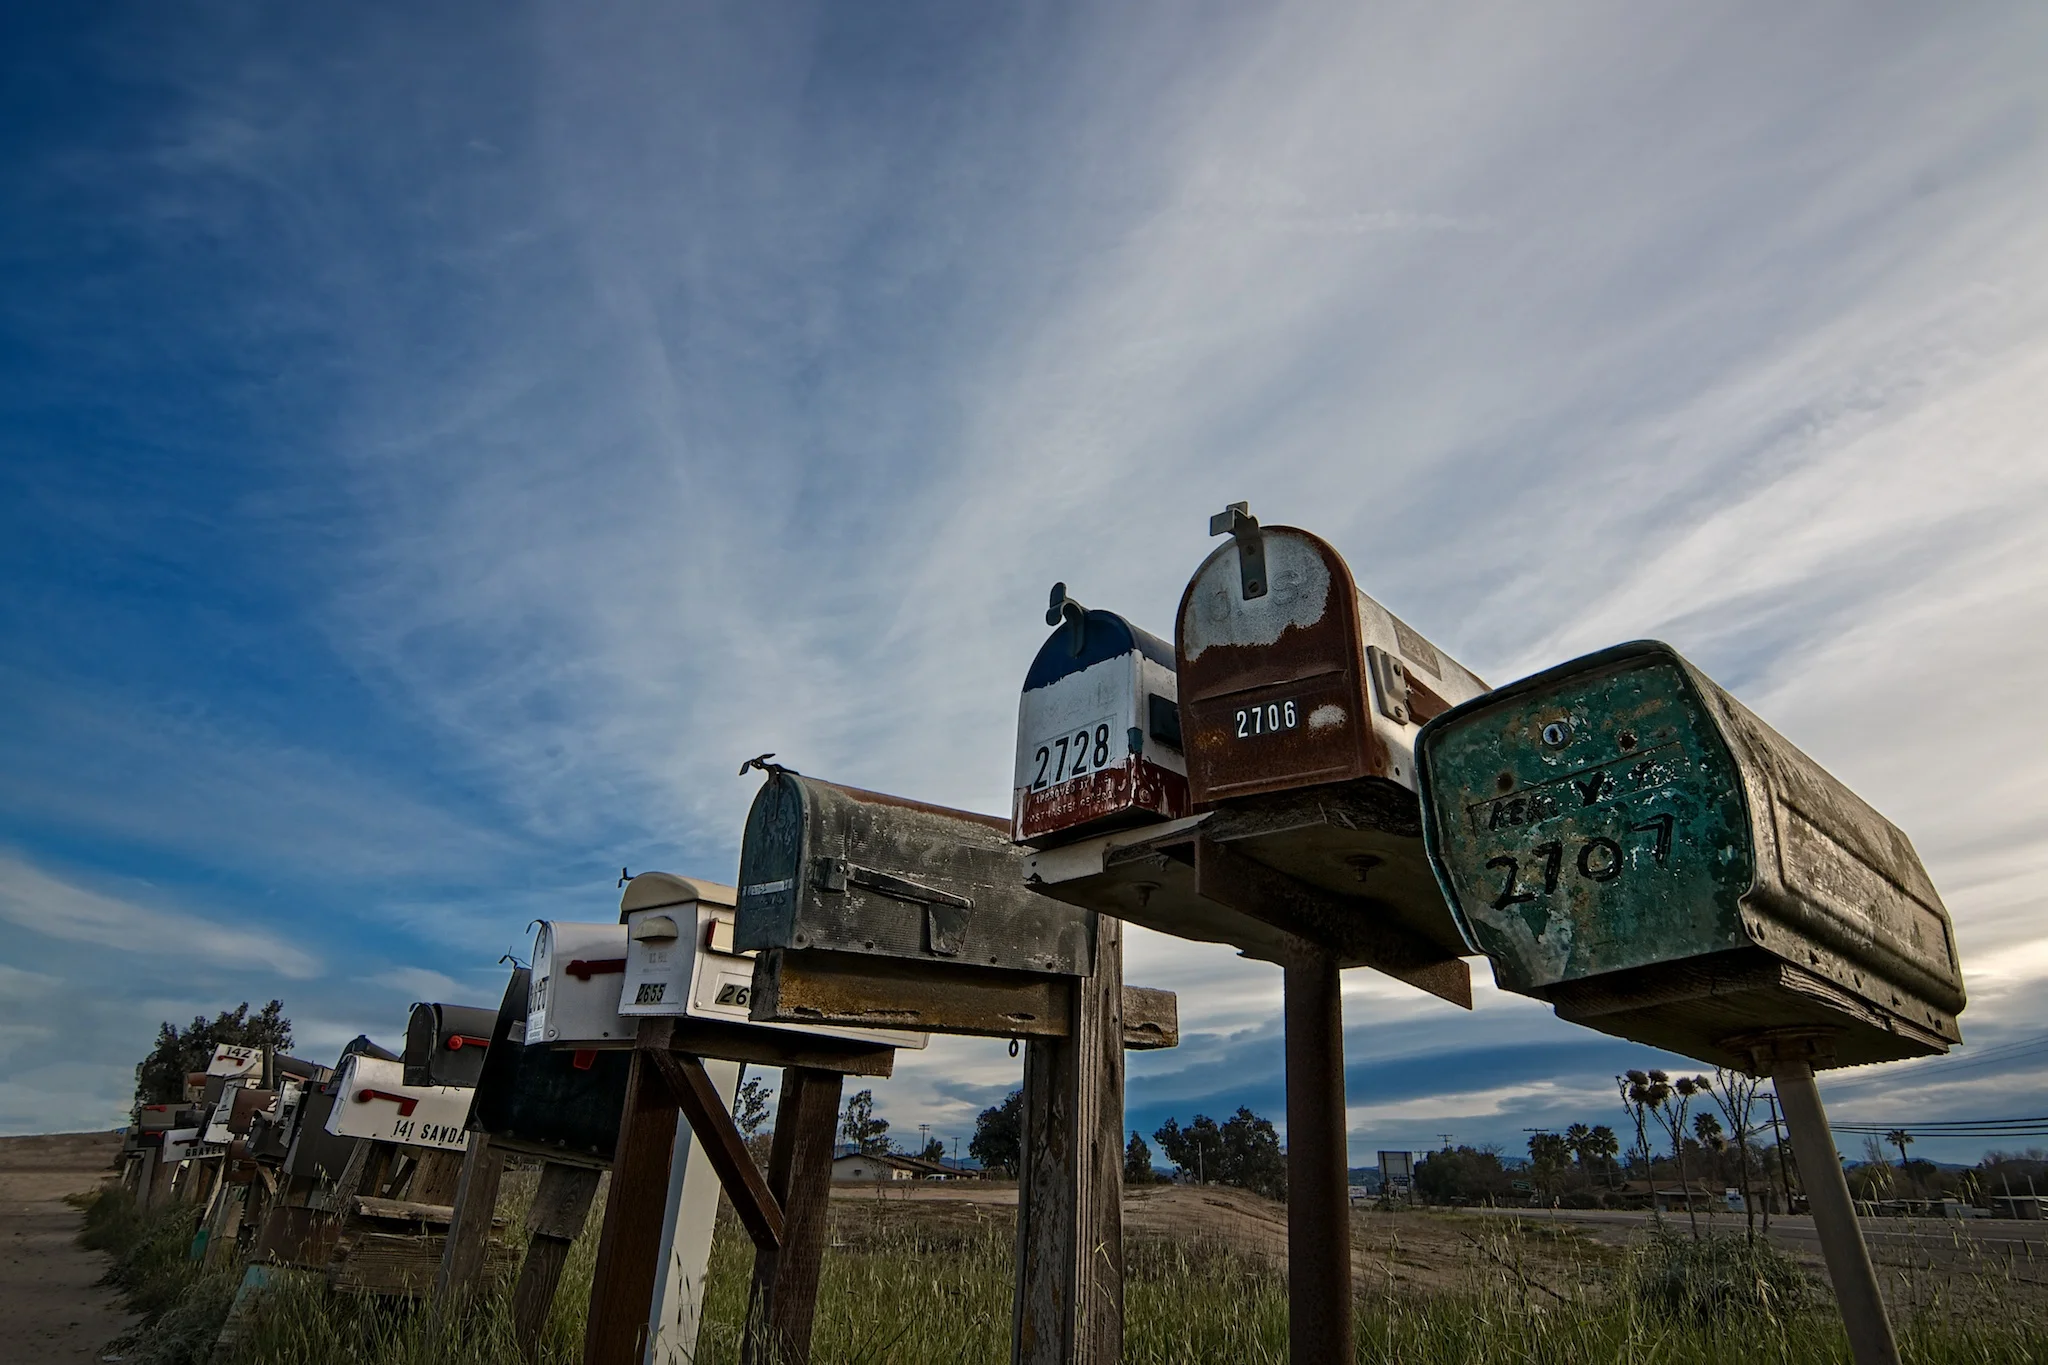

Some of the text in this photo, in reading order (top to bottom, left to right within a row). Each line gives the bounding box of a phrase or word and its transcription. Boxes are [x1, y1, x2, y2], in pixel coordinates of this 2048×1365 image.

[1235, 700, 1297, 739] 2706
[1033, 723, 1109, 791] 2728
[1485, 812, 1675, 910] 2707
[635, 983, 666, 1003] 2655
[719, 984, 751, 1005] 26
[226, 1046, 252, 1059] 142
[393, 1119, 415, 1138] 141
[185, 1145, 223, 1157] GRAVEL
